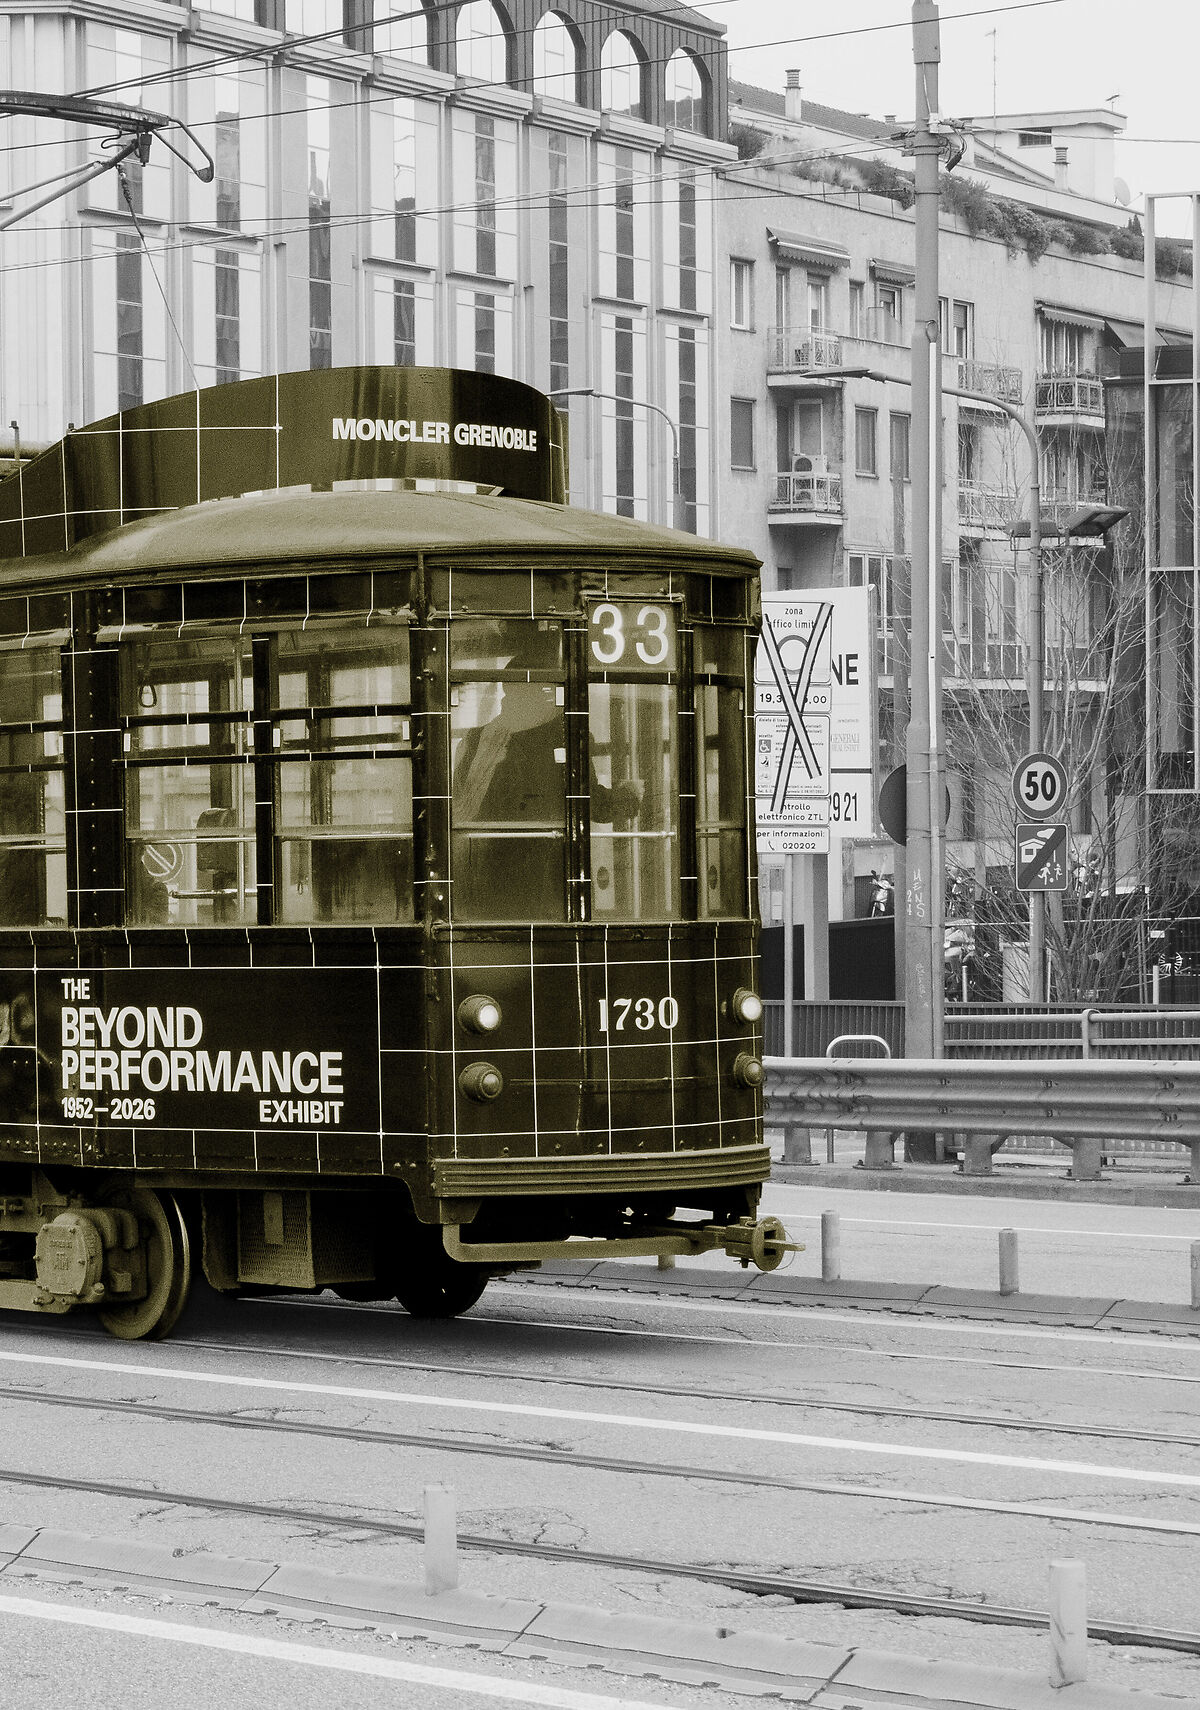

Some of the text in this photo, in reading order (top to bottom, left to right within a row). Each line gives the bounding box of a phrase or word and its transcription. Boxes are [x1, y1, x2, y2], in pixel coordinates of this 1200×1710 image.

[332, 417, 537, 452] MONCLER GRENOBLE
[784, 607, 804, 615] zona
[591, 603, 669, 665] 33
[1024, 770, 1057, 802] 50
[758, 813, 824, 821] elettronico ZTL
[782, 803, 811, 811] ntrollo
[756, 830, 825, 838] per informazioni:
[782, 842, 817, 850] 020202
[60, 977, 91, 1001] THE
[61, 1005, 203, 1048] BEYOND
[598, 996, 679, 1032] 1730
[61, 1049, 344, 1094] PERFORMANCE
[258, 1099, 344, 1124] EXHIBIT
